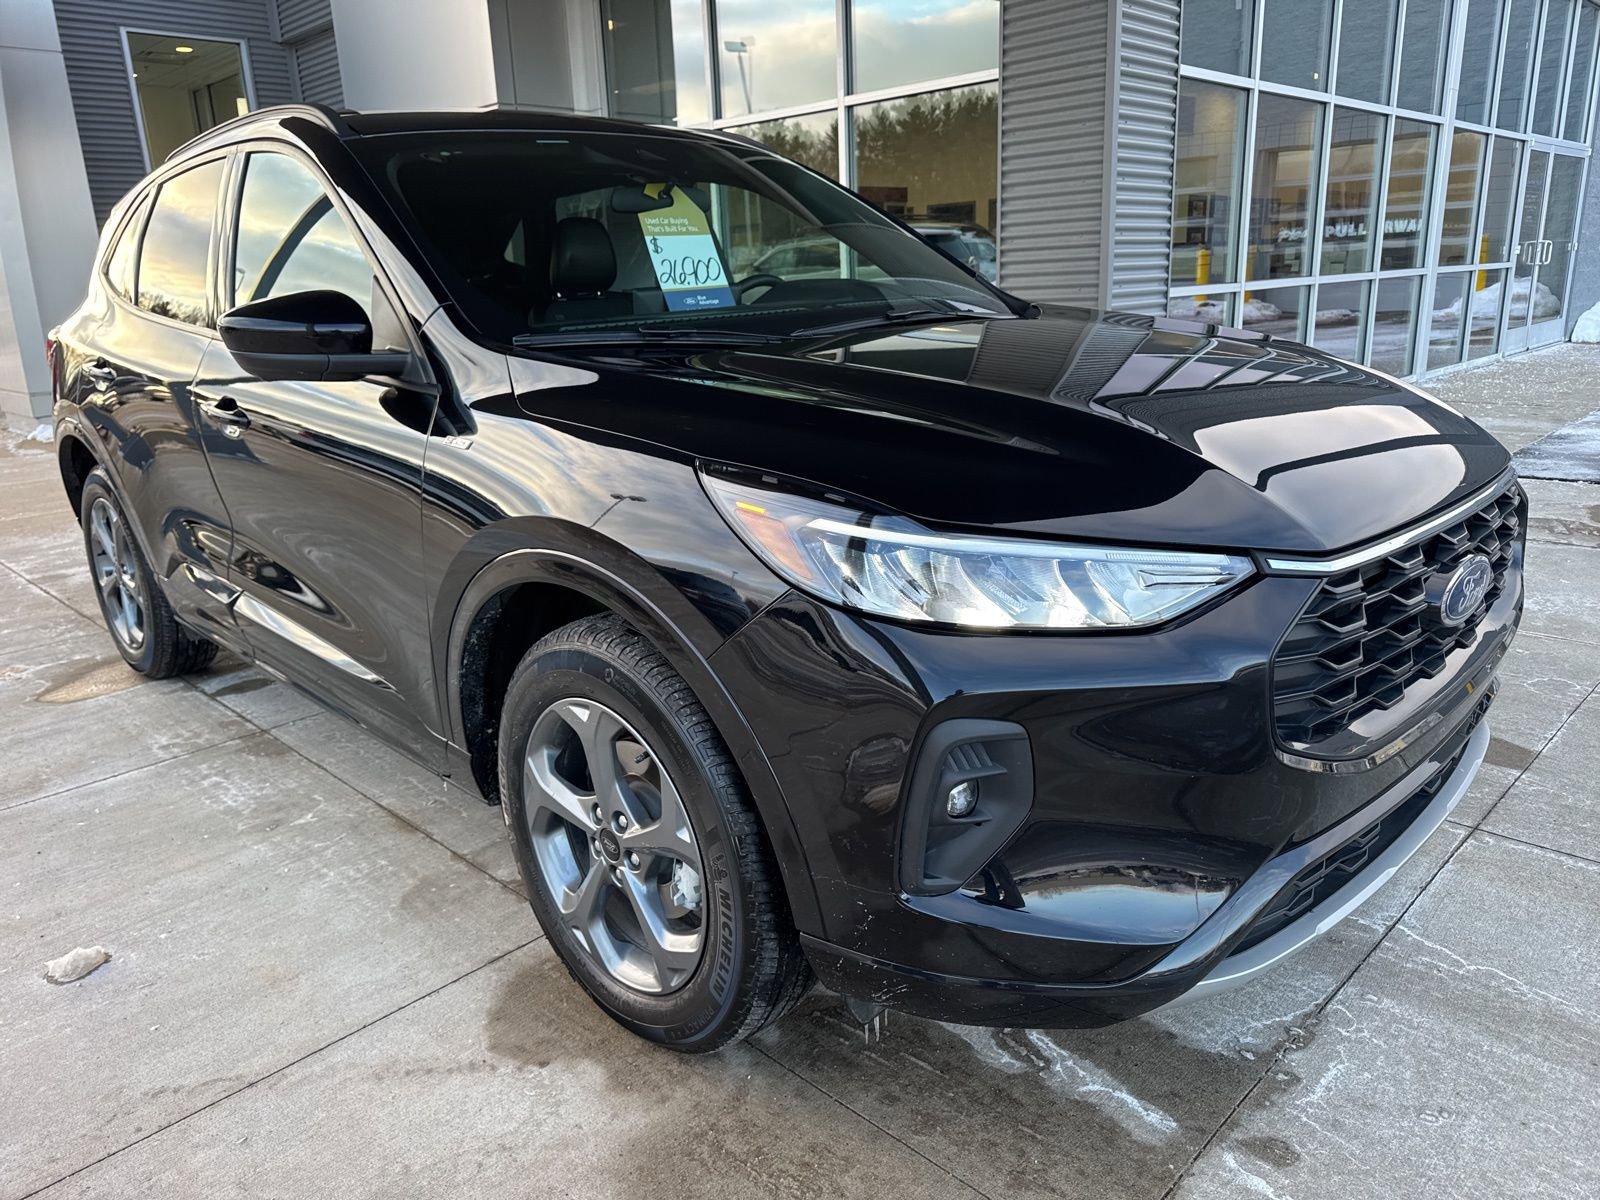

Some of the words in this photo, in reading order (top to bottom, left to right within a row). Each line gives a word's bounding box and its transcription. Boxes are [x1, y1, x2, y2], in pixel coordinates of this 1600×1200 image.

[645, 217, 659, 225] Used
[660, 217, 669, 225] Car
[670, 217, 688, 226] Buying
[1325, 222, 1367, 238] PULL
[650, 236, 663, 254] $
[1457, 568, 1488, 613] Ford
[713, 887, 733, 998] MICHELIN
